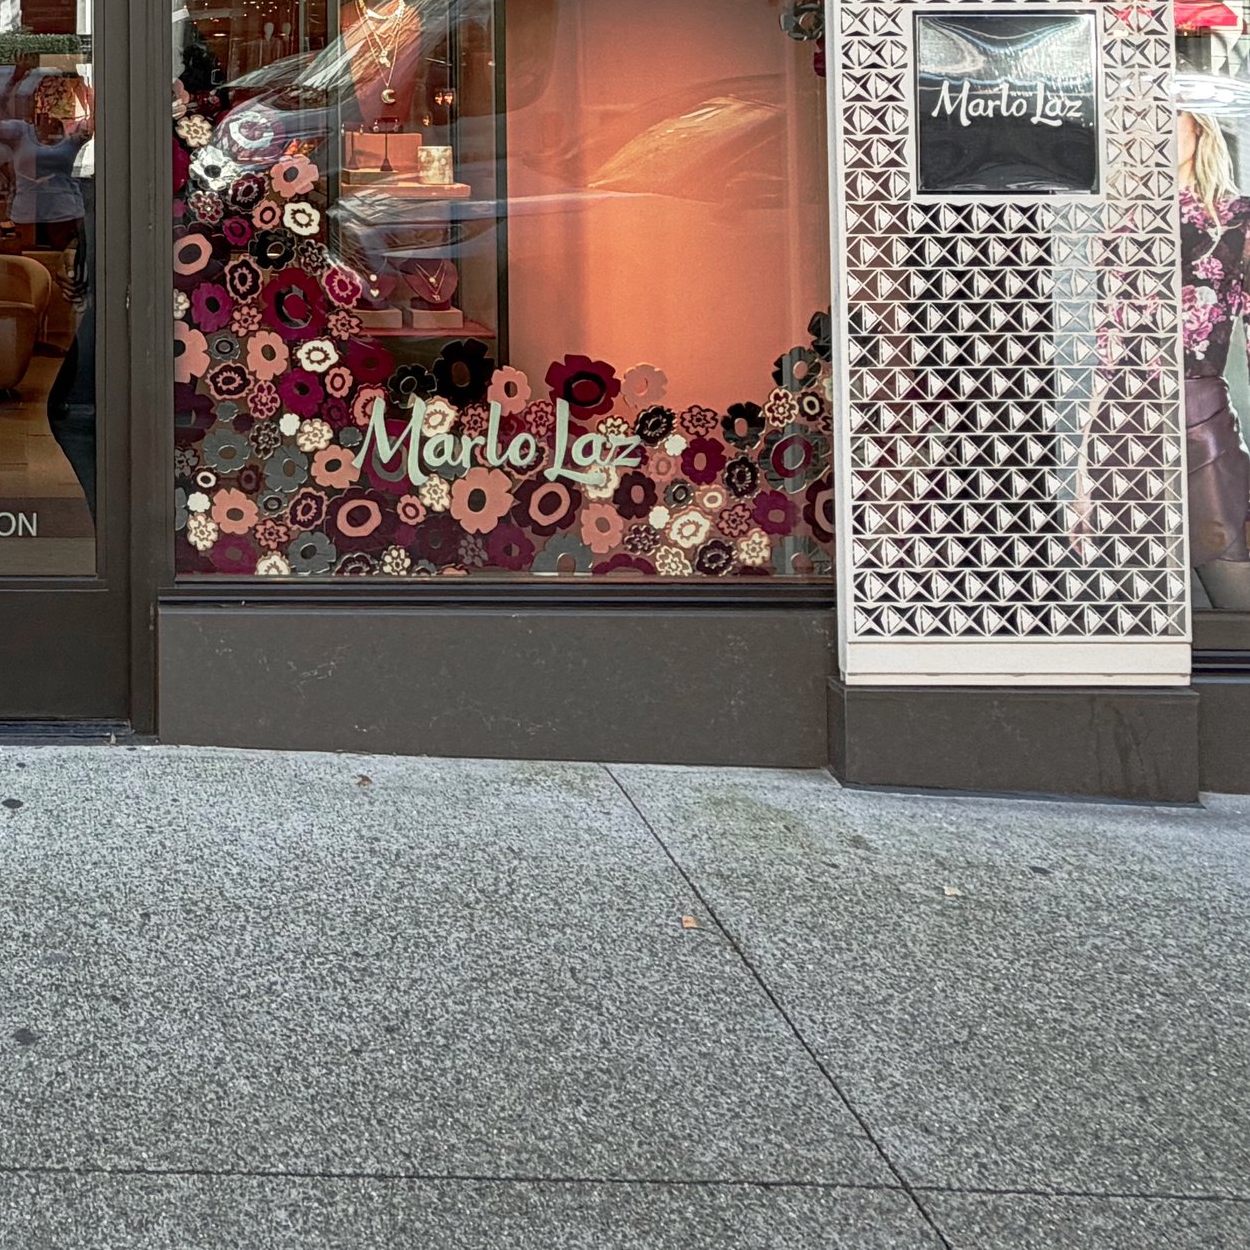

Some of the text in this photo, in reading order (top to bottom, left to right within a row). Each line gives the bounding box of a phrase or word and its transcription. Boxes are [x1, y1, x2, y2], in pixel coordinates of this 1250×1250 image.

[932, 79, 1084, 127] Marlo Laz
[352, 396, 642, 485] Marlo Laz
